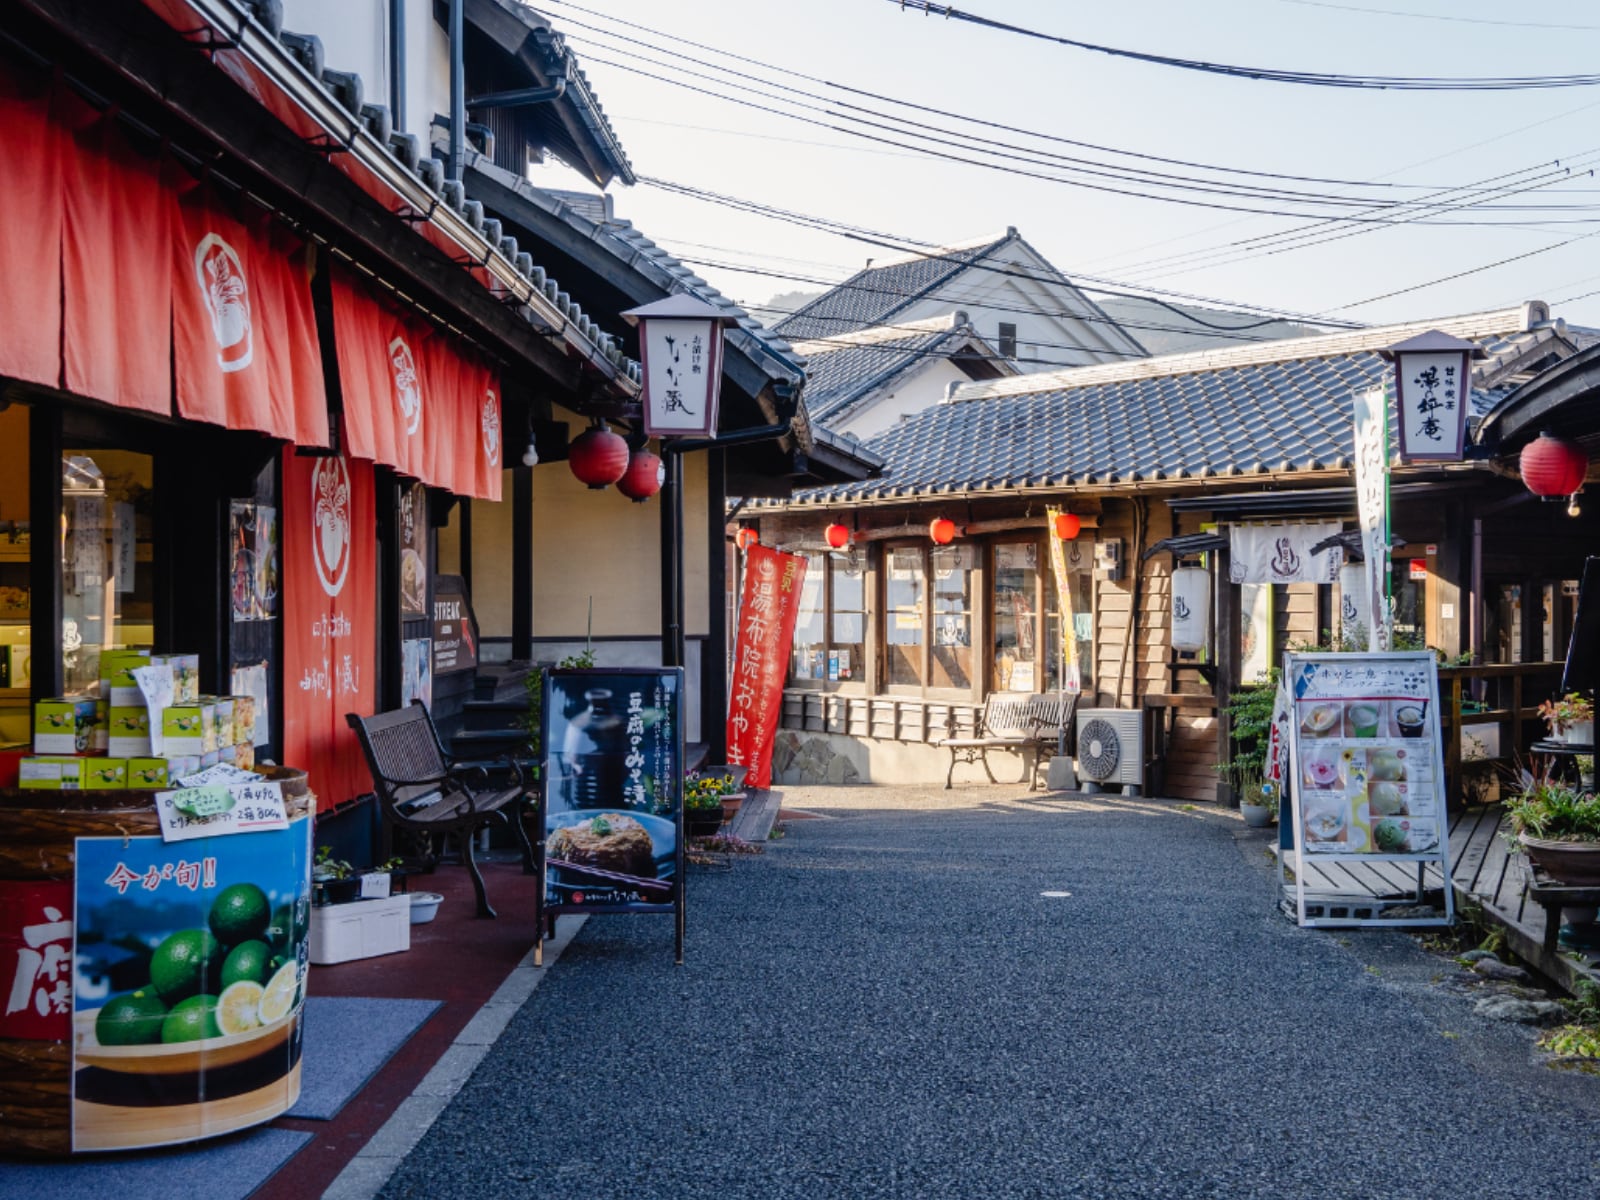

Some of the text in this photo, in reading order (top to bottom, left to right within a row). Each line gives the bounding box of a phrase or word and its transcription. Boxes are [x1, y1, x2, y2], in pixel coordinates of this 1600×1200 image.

[1444, 365, 1455, 411] 甘味喫茶
[623, 691, 647, 805] 豆腐のみそ漬
